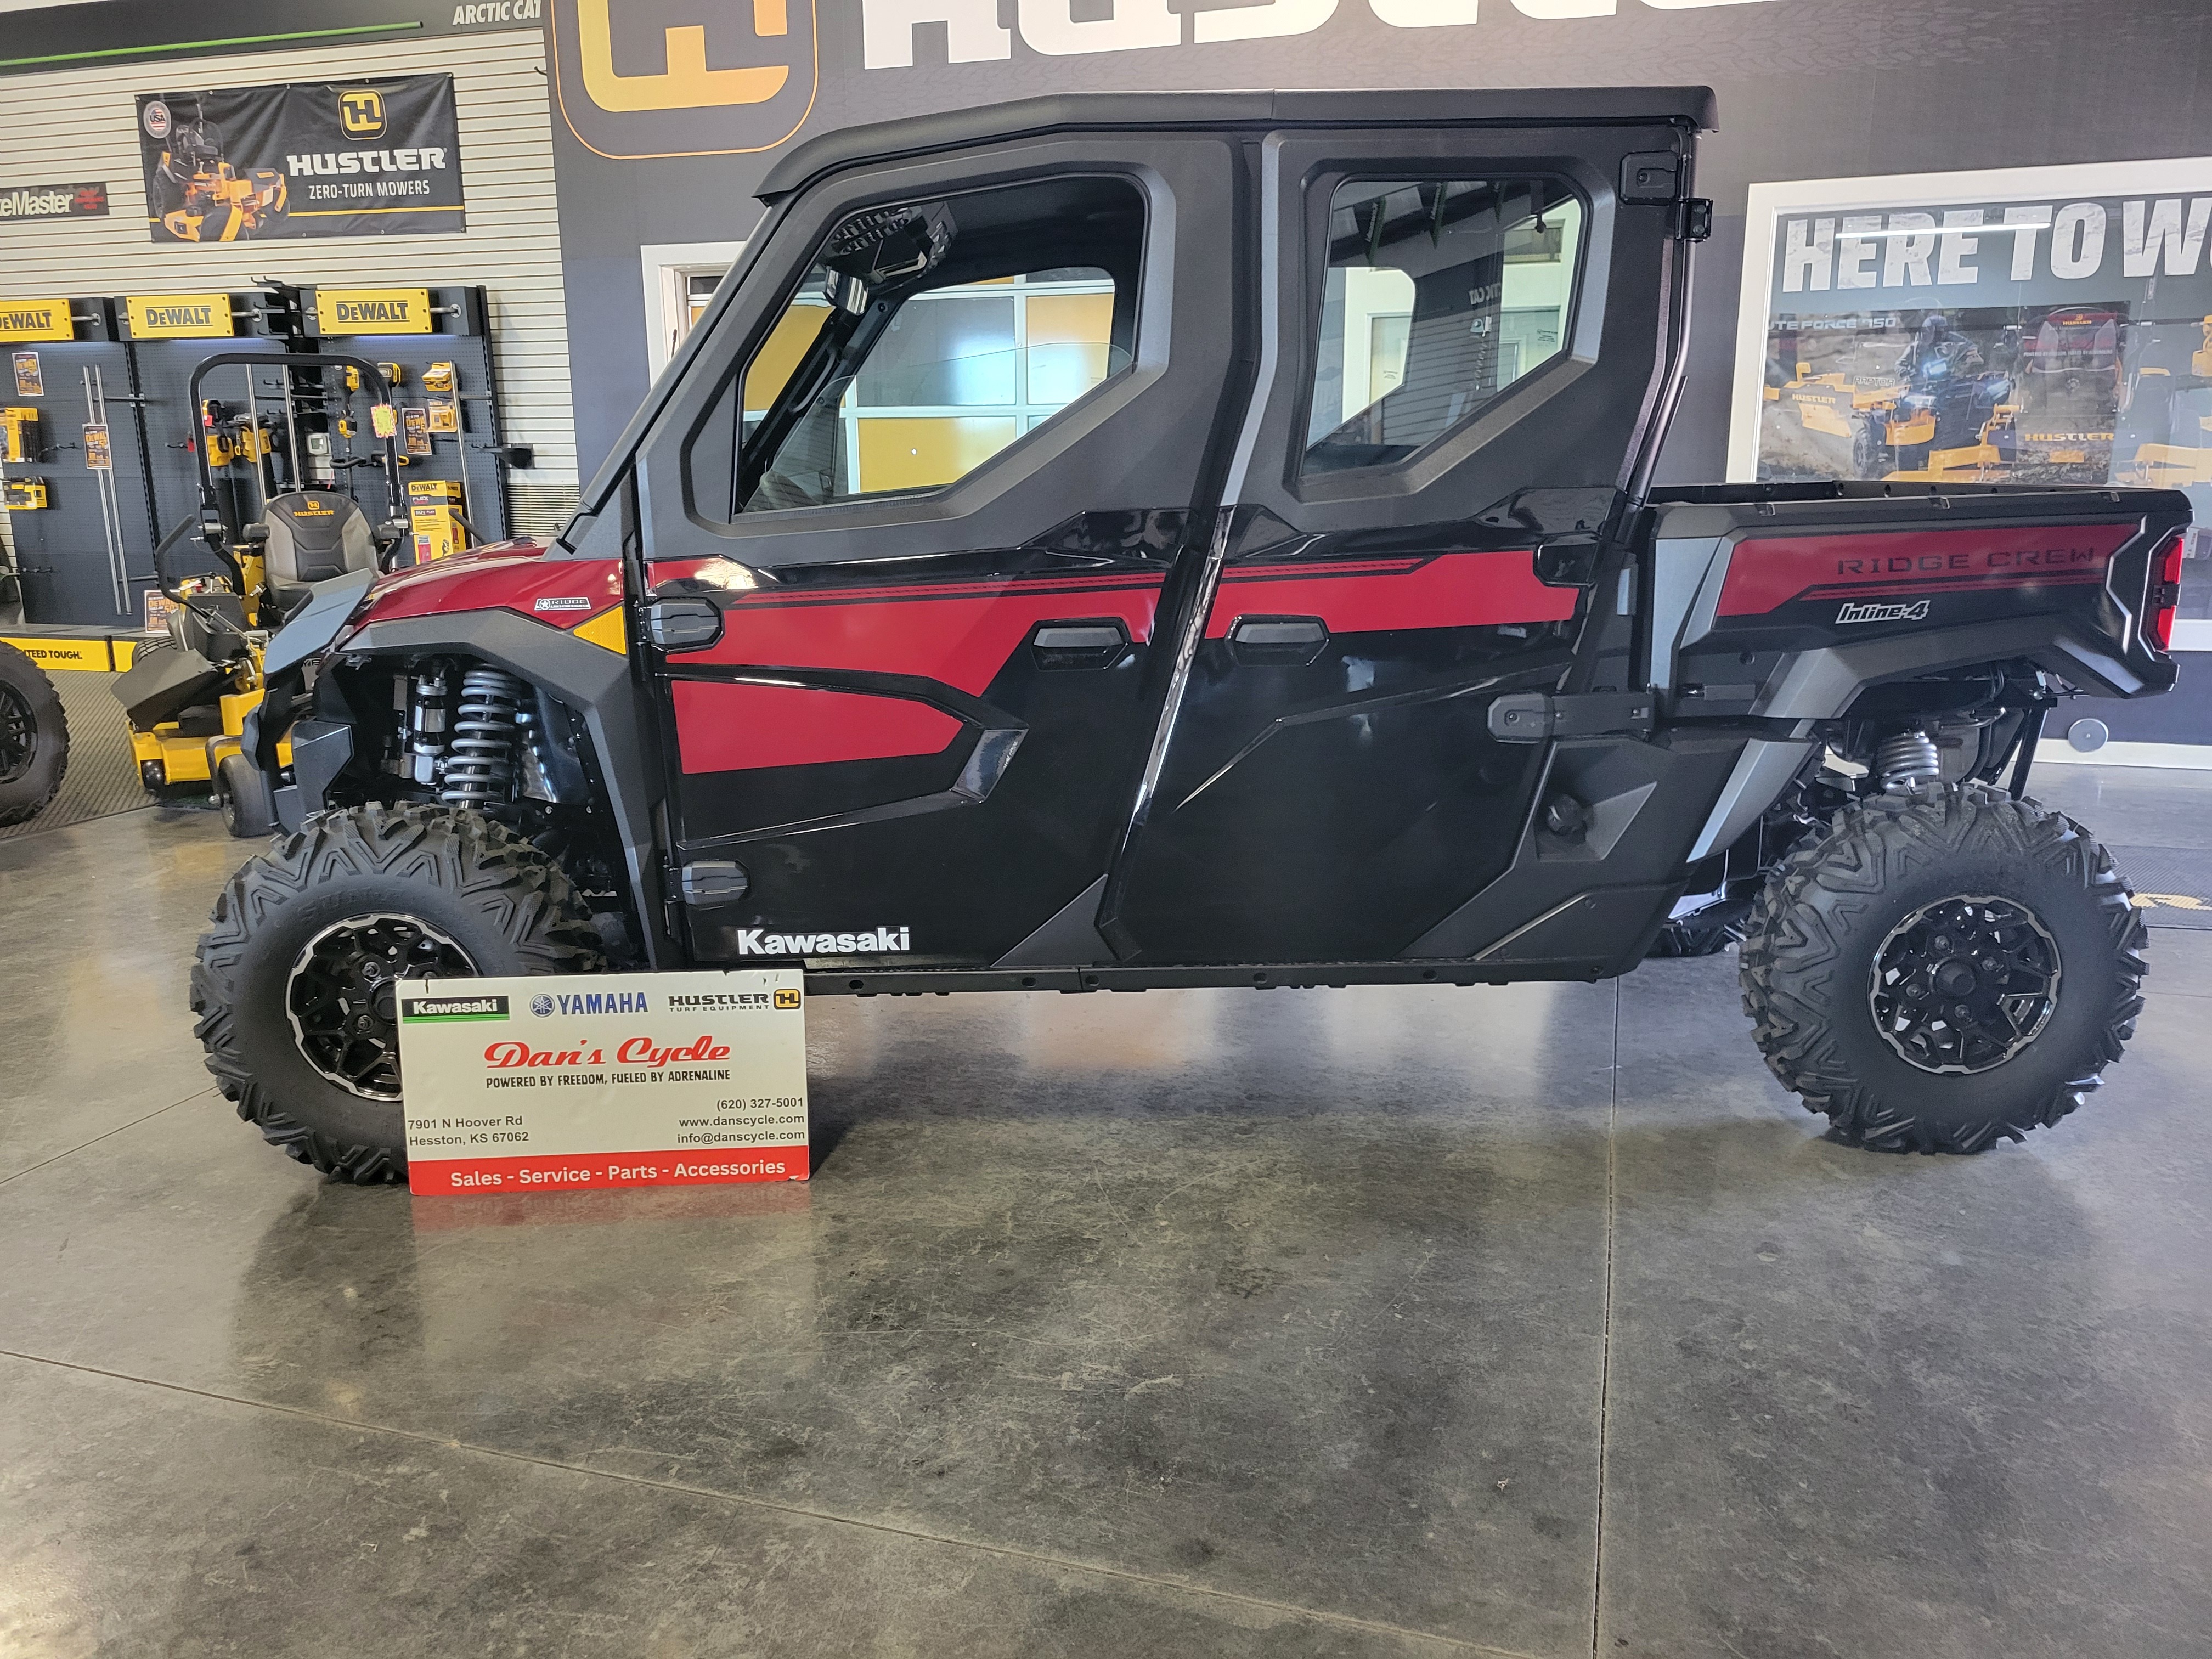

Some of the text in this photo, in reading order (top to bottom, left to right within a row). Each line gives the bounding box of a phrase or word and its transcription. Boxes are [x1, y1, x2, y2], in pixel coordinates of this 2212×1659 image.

[452, 0, 541, 25] ARCTIC CAT
[149, 114, 166, 122] USA
[286, 148, 447, 176] HUSTLER
[308, 180, 430, 200] ZERO-TURN MOWERS
[0, 191, 74, 216] eMaster
[1782, 197, 2212, 292] HERE TO W
[0, 312, 52, 329] EWALT
[1801, 319, 1857, 330] FORCE
[1862, 318, 1896, 328] 750
[1853, 376, 1895, 387] RAPTOR
[1792, 394, 1836, 404] HUSTLER
[2024, 432, 2114, 441] HUSTLER
[1837, 548, 2094, 575] RIDGE CREW
[1835, 600, 1931, 624] Inline-4
[737, 927, 910, 955] Kawasaki
[413, 998, 498, 1014] Kawasaki
[557, 992, 648, 1015] YAMAHA
[668, 994, 769, 1006] HUSTLER
[484, 1035, 730, 1069] Dan's Cycle
[486, 1070, 731, 1088] POWERED BY FREEDOM, FUELED BY ADRENALINE
[717, 1097, 803, 1112] (620) 327-5001
[408, 1115, 523, 1130] 7901 N Hoover Rd
[679, 1115, 805, 1127] www.danscycle.com
[409, 1132, 529, 1146] Hesston, KS 67062
[677, 1131, 805, 1145] info@danscycle.com
[450, 1172, 503, 1187] Sales
[519, 1168, 591, 1184] Service
[608, 1165, 658, 1181] Parts
[674, 1160, 786, 1178] Accessories
